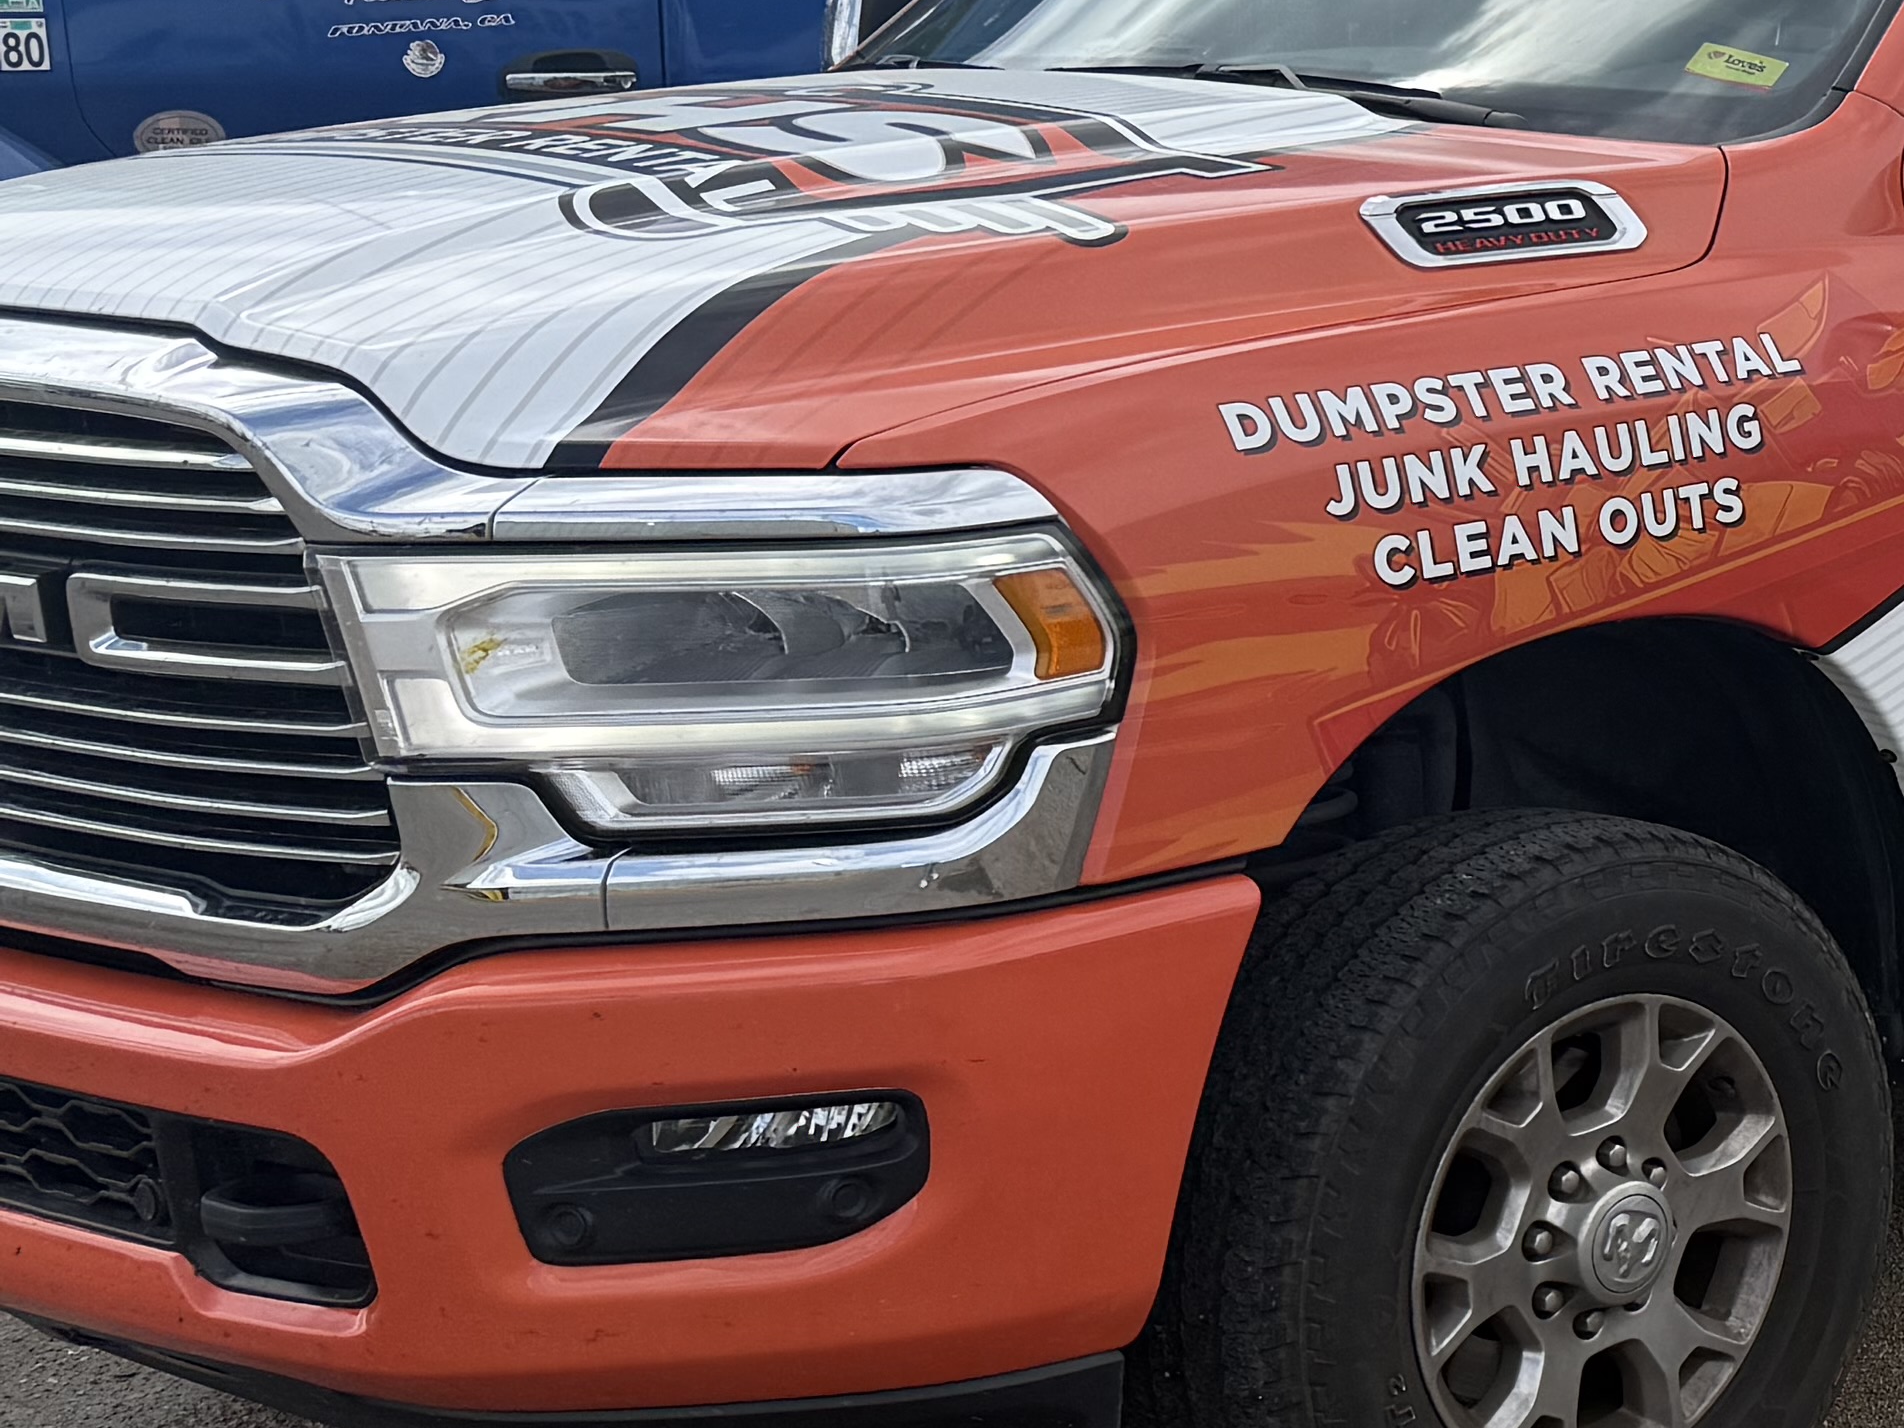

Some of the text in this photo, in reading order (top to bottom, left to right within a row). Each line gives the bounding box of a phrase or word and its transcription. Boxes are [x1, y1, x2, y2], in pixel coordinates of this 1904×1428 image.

[328, 13, 516, 38] FONTANA, CA
[500, 130, 777, 212] RENTAL
[1415, 198, 1587, 234] 2500
[1434, 227, 1600, 254] HEAVY DUTY
[1219, 333, 1801, 453] DUMPSTER RENTAL
[1326, 403, 1763, 517] JUNK HAULING
[1373, 477, 1746, 587] CLEAN OUTS
[1524, 923, 1844, 1093] Firestone
